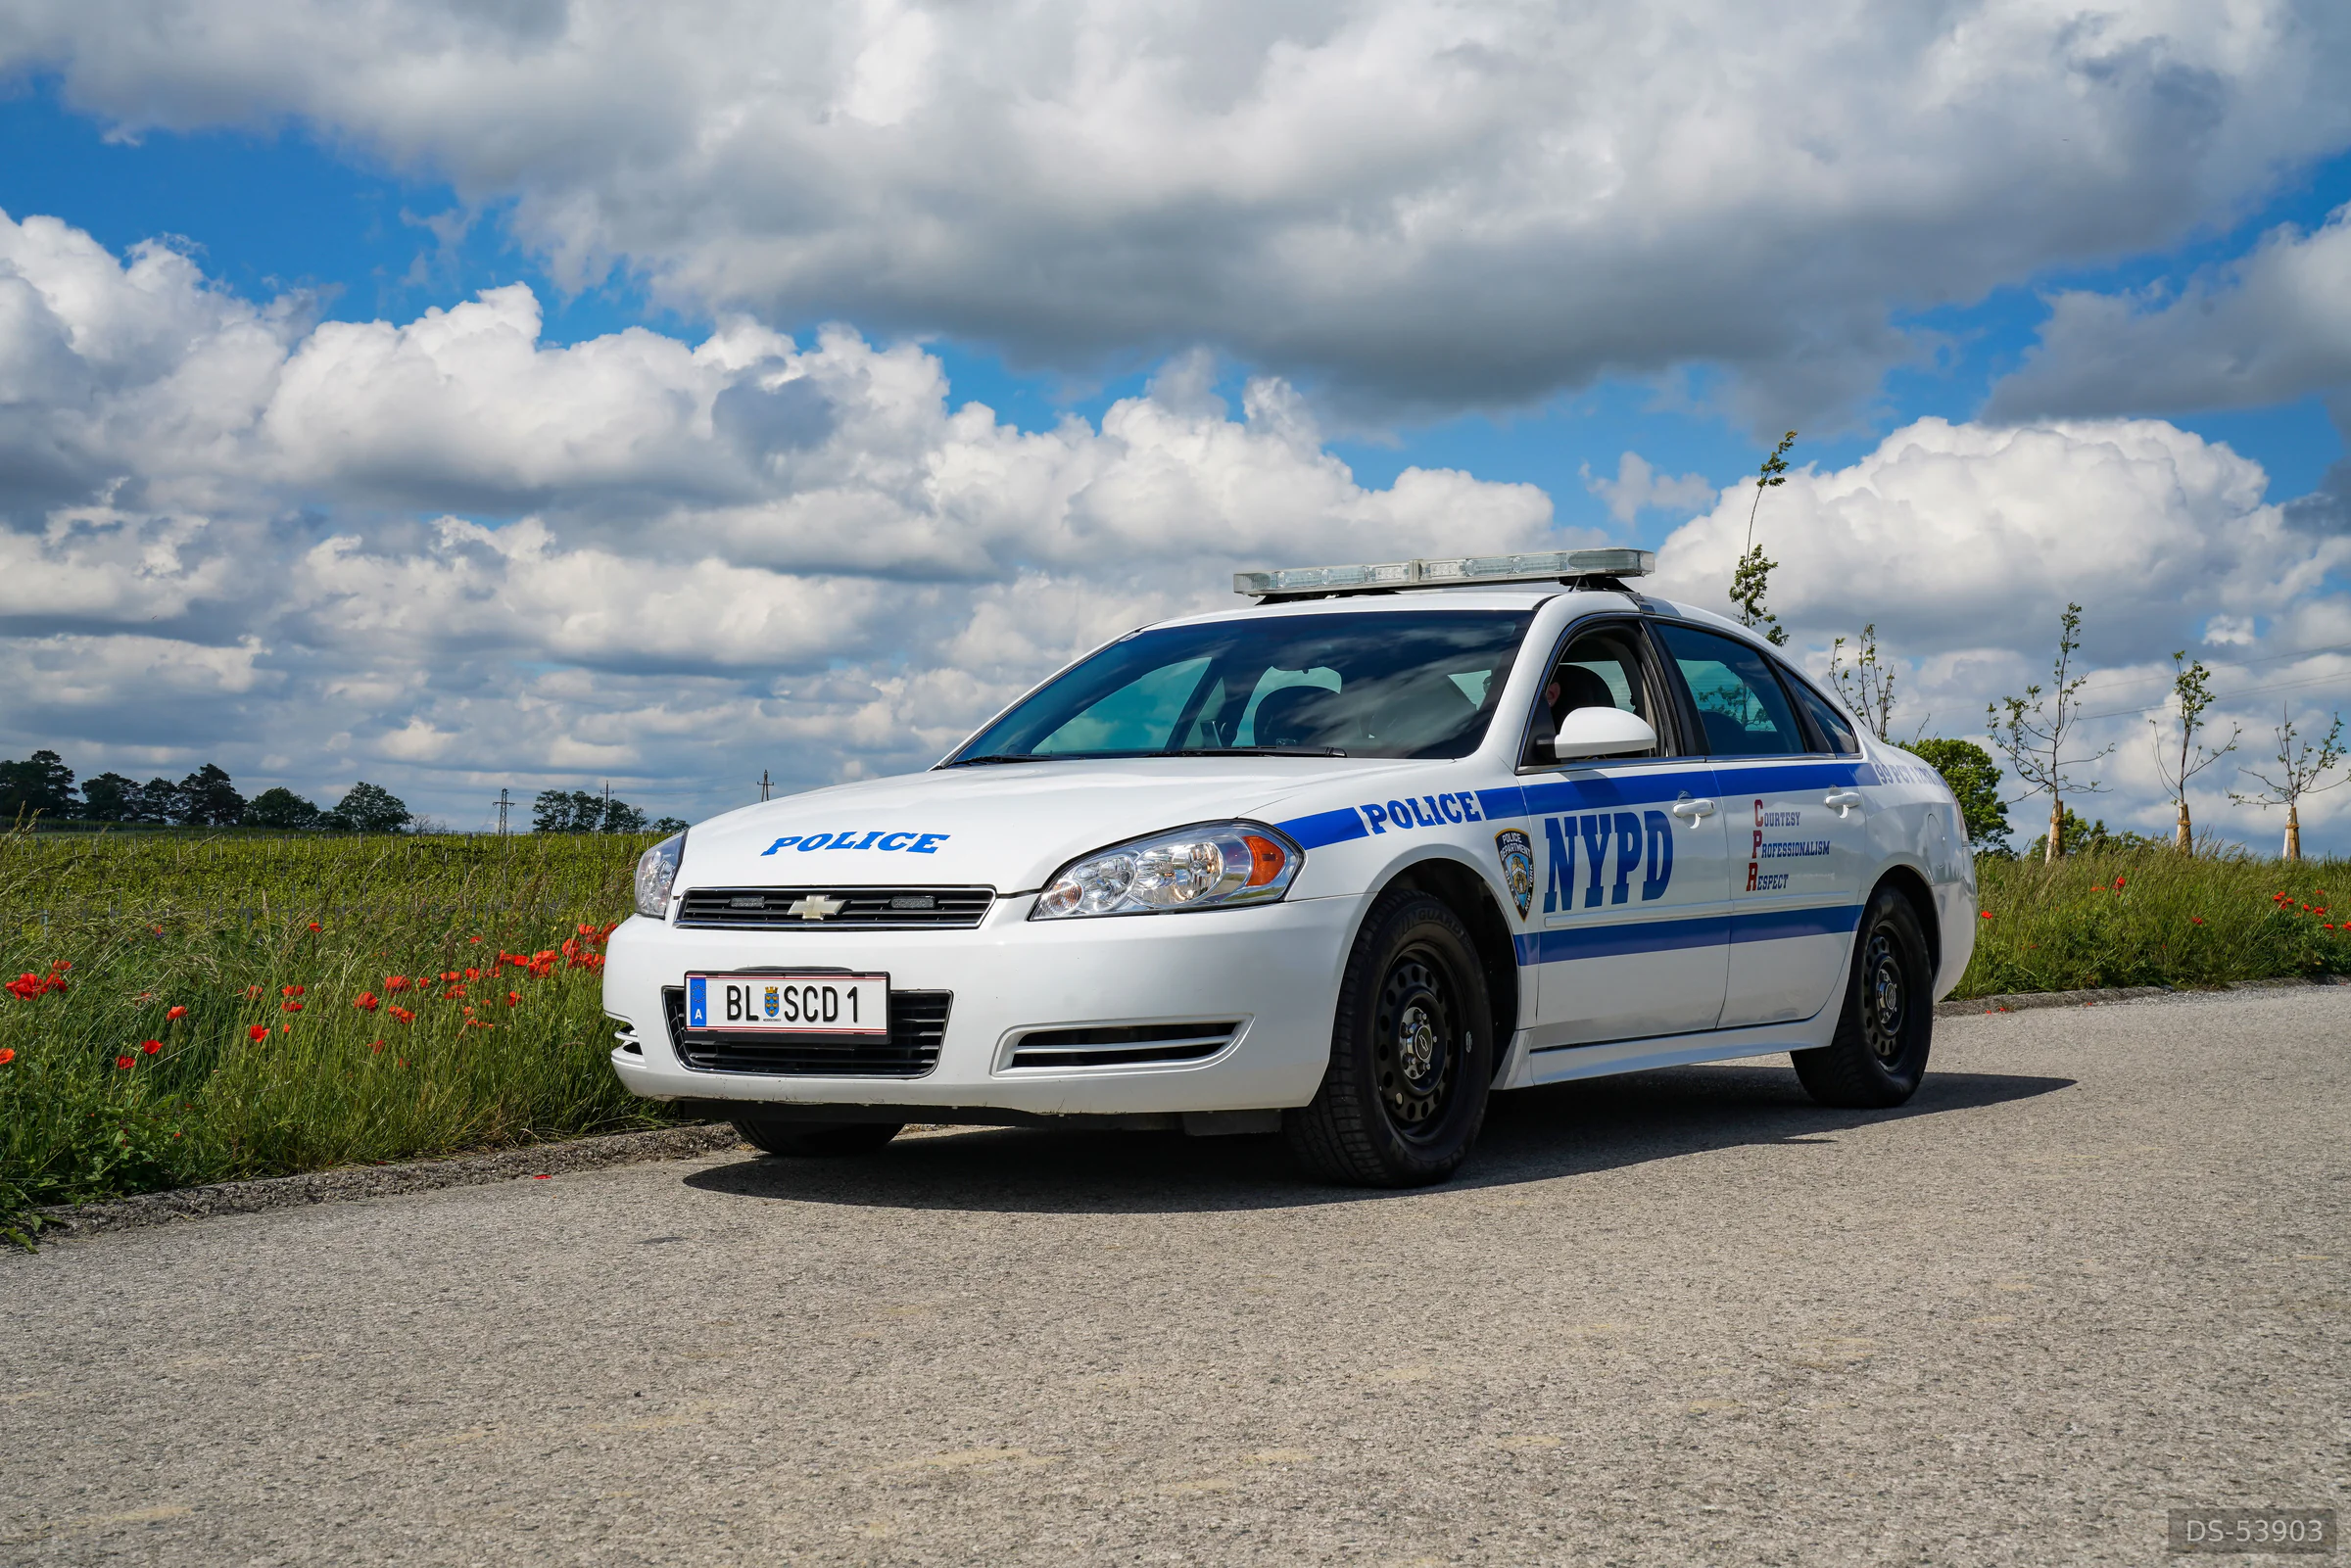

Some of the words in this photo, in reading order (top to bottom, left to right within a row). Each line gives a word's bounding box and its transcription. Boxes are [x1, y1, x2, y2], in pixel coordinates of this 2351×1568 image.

[1874, 763, 1894, 784] 99
[1889, 764, 1915, 784] PCT
[1359, 790, 1482, 835] POLICE
[1753, 798, 1800, 828] COURTESY
[760, 830, 951, 857] POLICE
[1500, 842, 1531, 862] DEPARTMENT
[1502, 832, 1522, 844] POLICE
[1751, 830, 1830, 859] PROFESSIONALISM
[1543, 810, 1674, 914] NYPD
[1746, 862, 1789, 892] RESPECT
[694, 1008, 703, 1021] A
[726, 985, 759, 1022] BL
